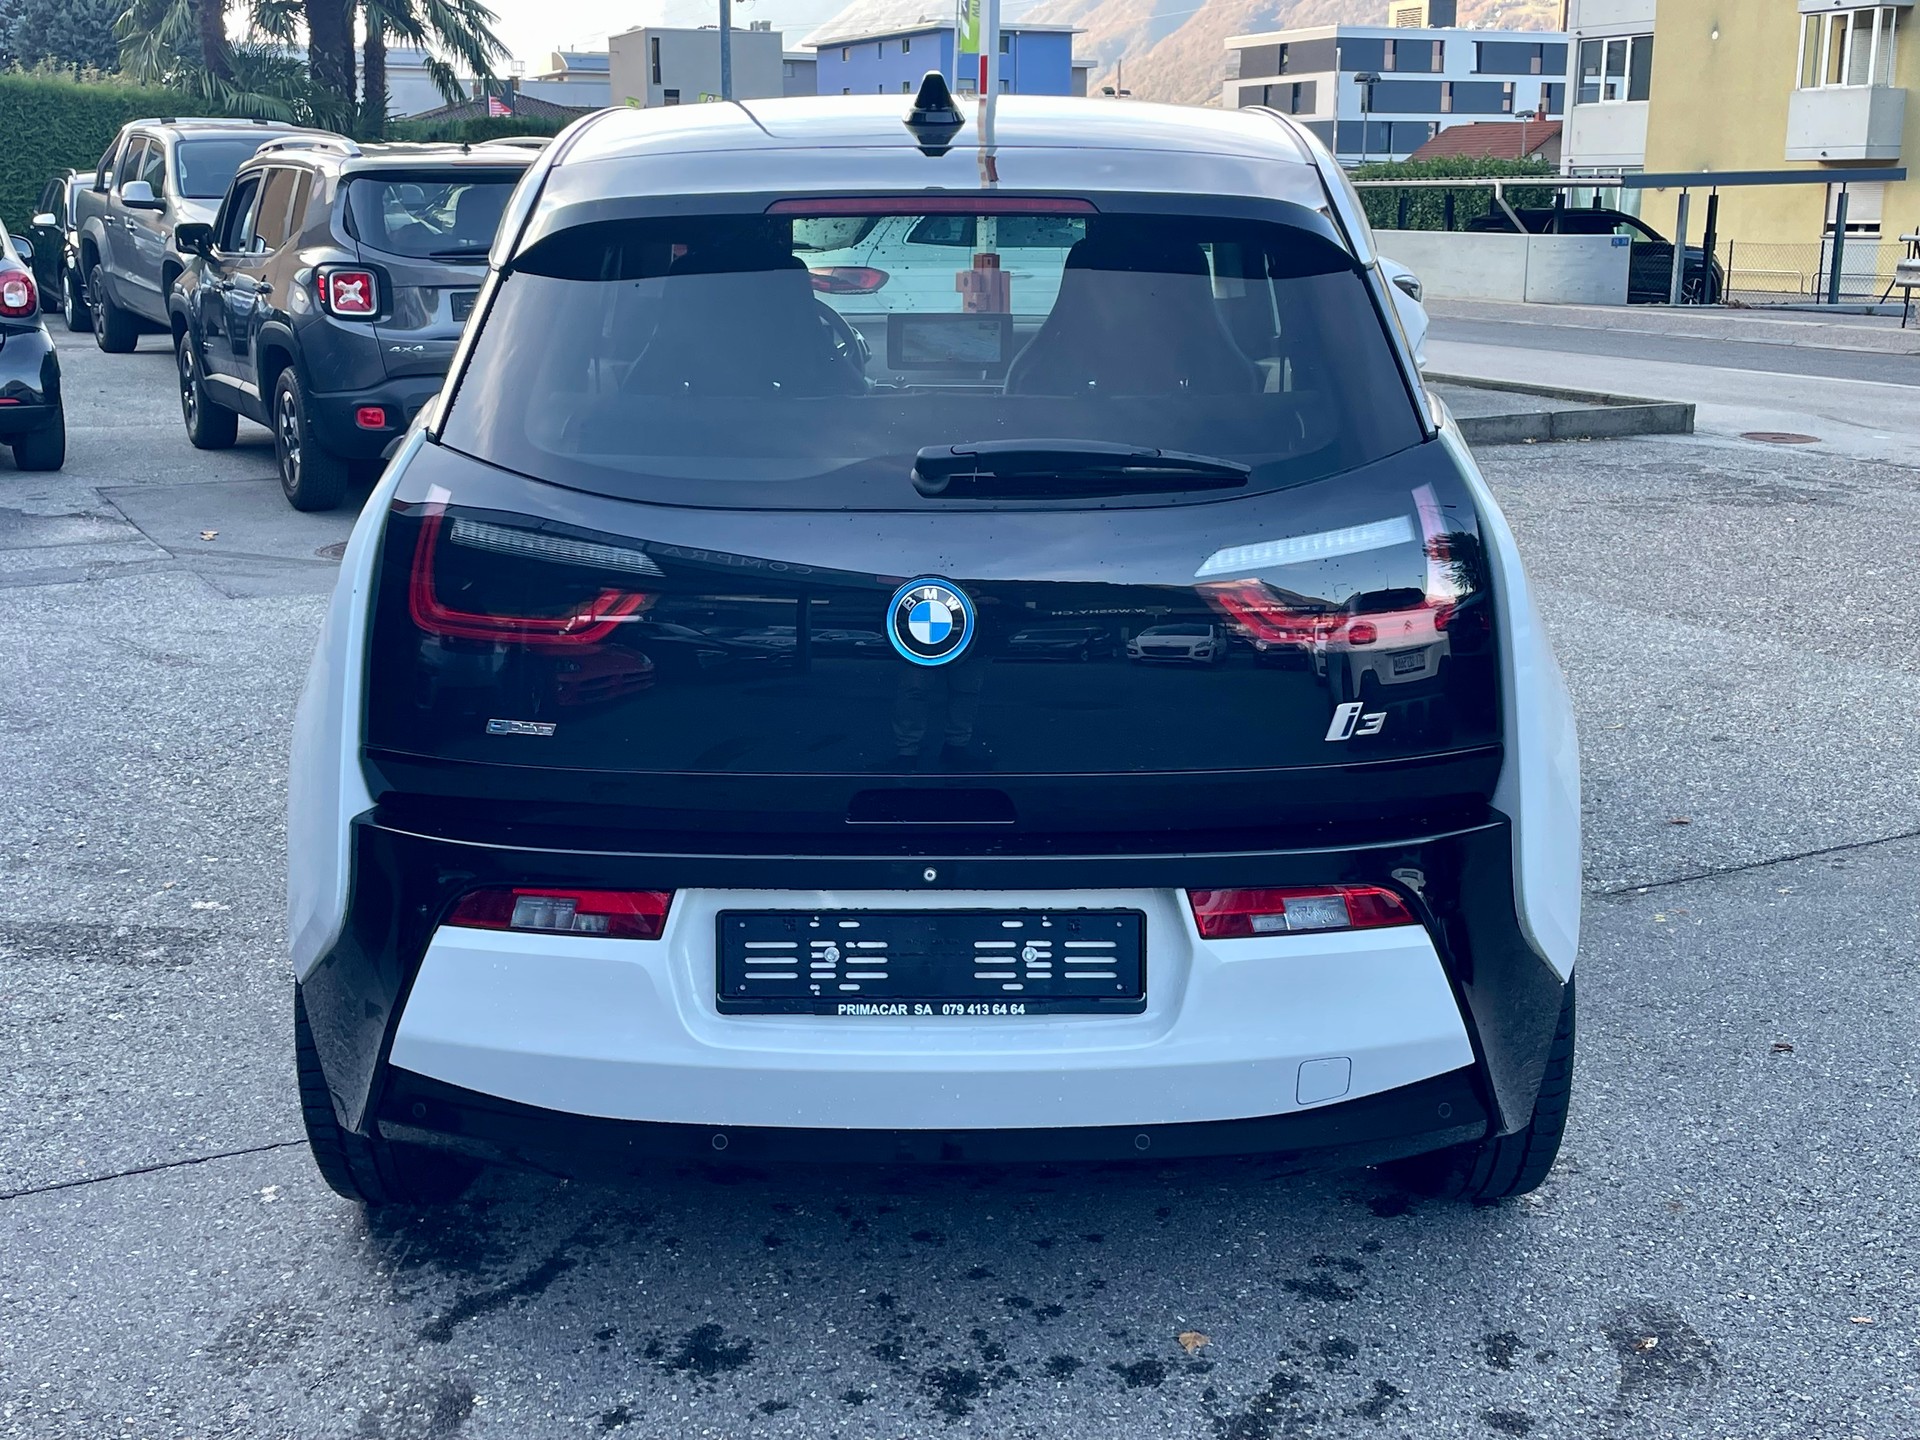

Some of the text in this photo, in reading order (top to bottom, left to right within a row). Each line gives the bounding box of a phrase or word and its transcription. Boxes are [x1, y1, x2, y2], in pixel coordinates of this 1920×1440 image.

[902, 588, 961, 612] BMW
[1325, 702, 1388, 741] i3
[837, 1003, 1026, 1015] PRIMACAR SA 079 413 64 64
